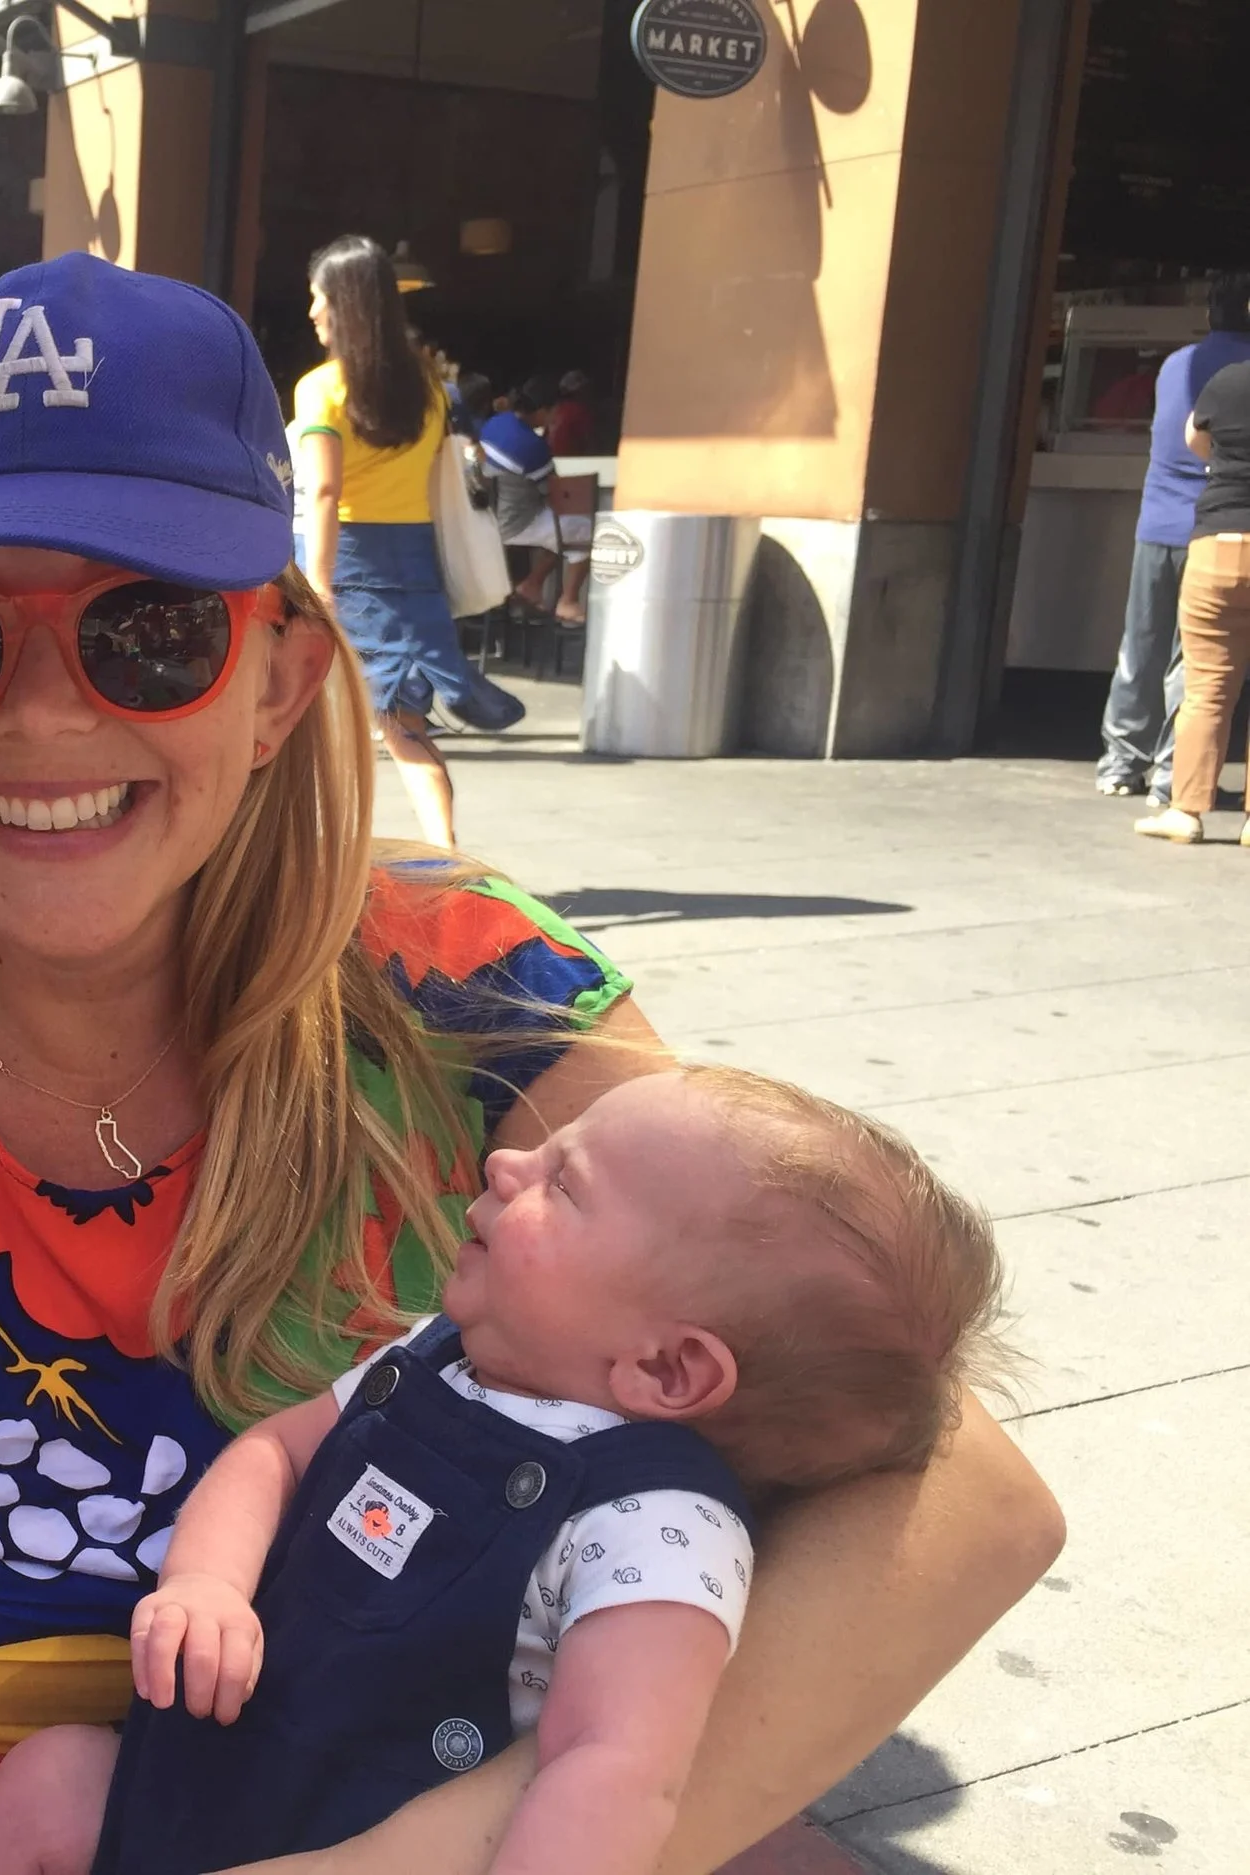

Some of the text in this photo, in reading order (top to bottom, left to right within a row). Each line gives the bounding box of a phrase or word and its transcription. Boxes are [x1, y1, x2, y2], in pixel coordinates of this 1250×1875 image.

[647, 28, 756, 62] MARKET
[356, 1494, 366, 1506] 2
[395, 1523, 406, 1536] 8
[336, 1517, 393, 1566] ALWAYS CUTE
